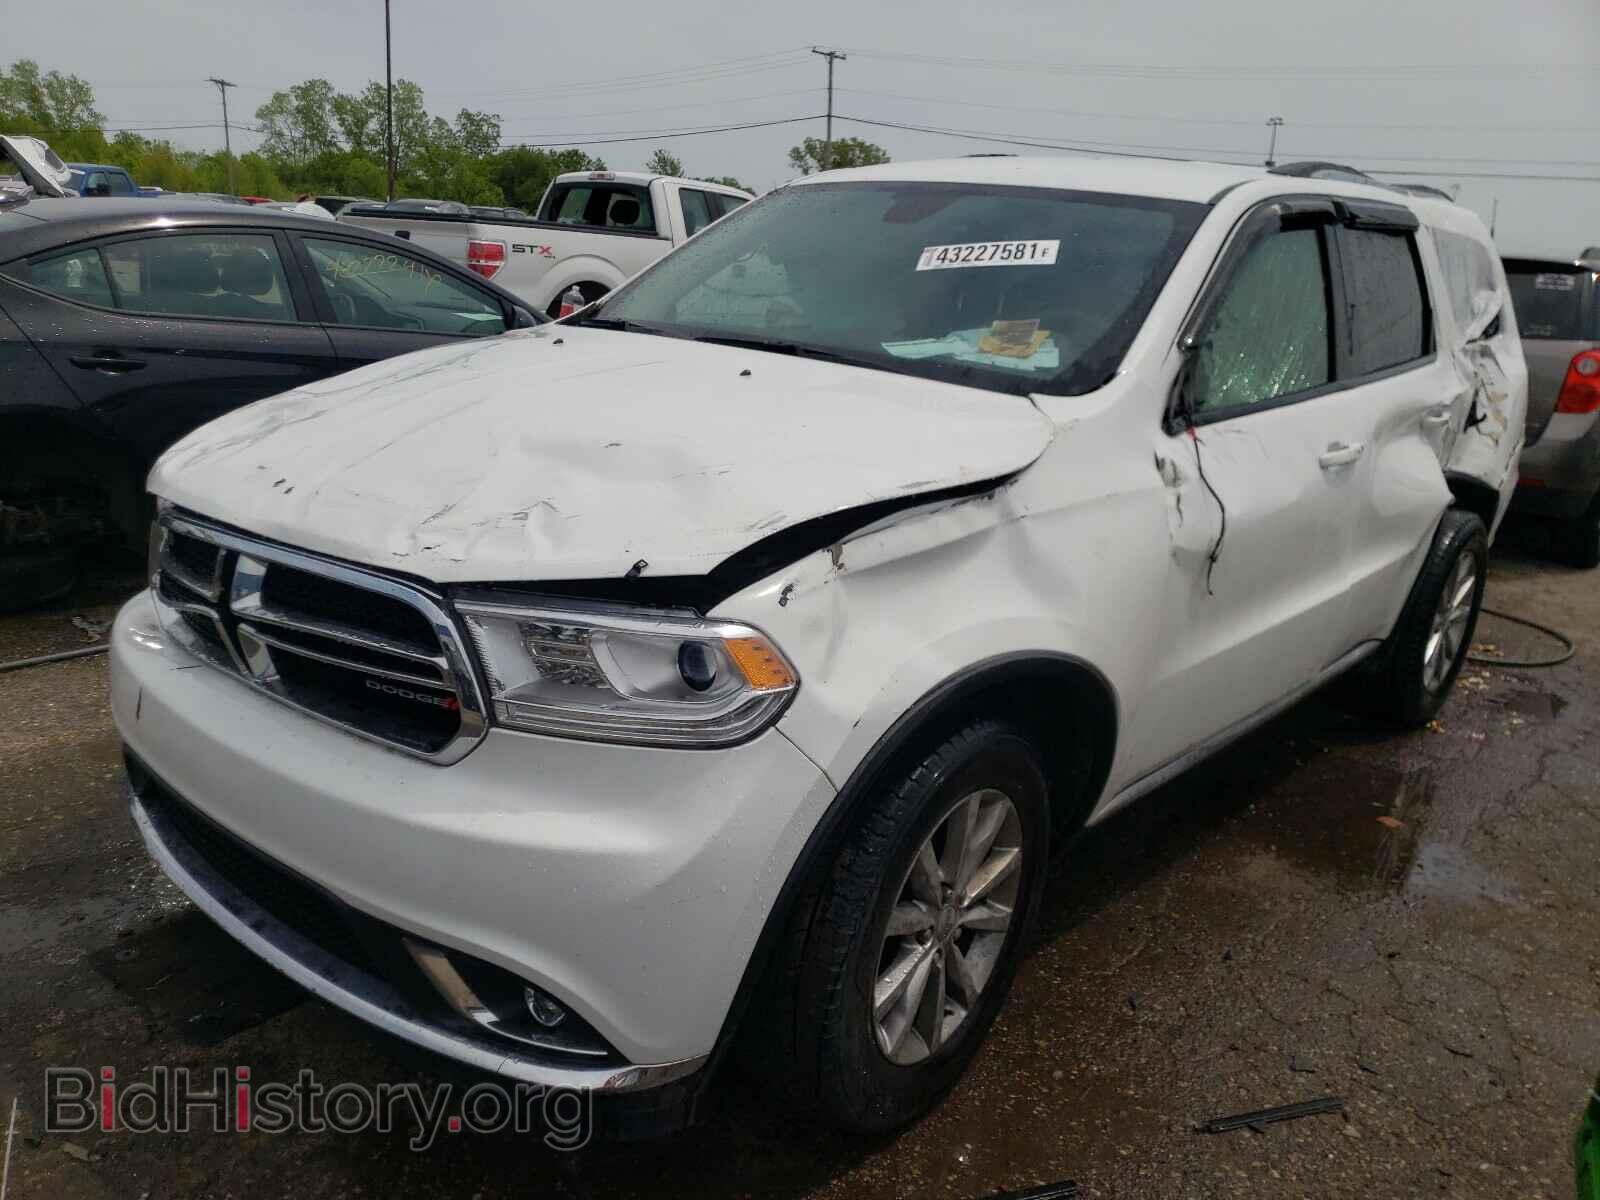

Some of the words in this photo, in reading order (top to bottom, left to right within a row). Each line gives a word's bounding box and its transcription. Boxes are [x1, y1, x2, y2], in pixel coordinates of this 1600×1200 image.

[511, 243, 552, 255] STX
[936, 243, 1037, 263] 43227581
[366, 680, 449, 708] DODGE
